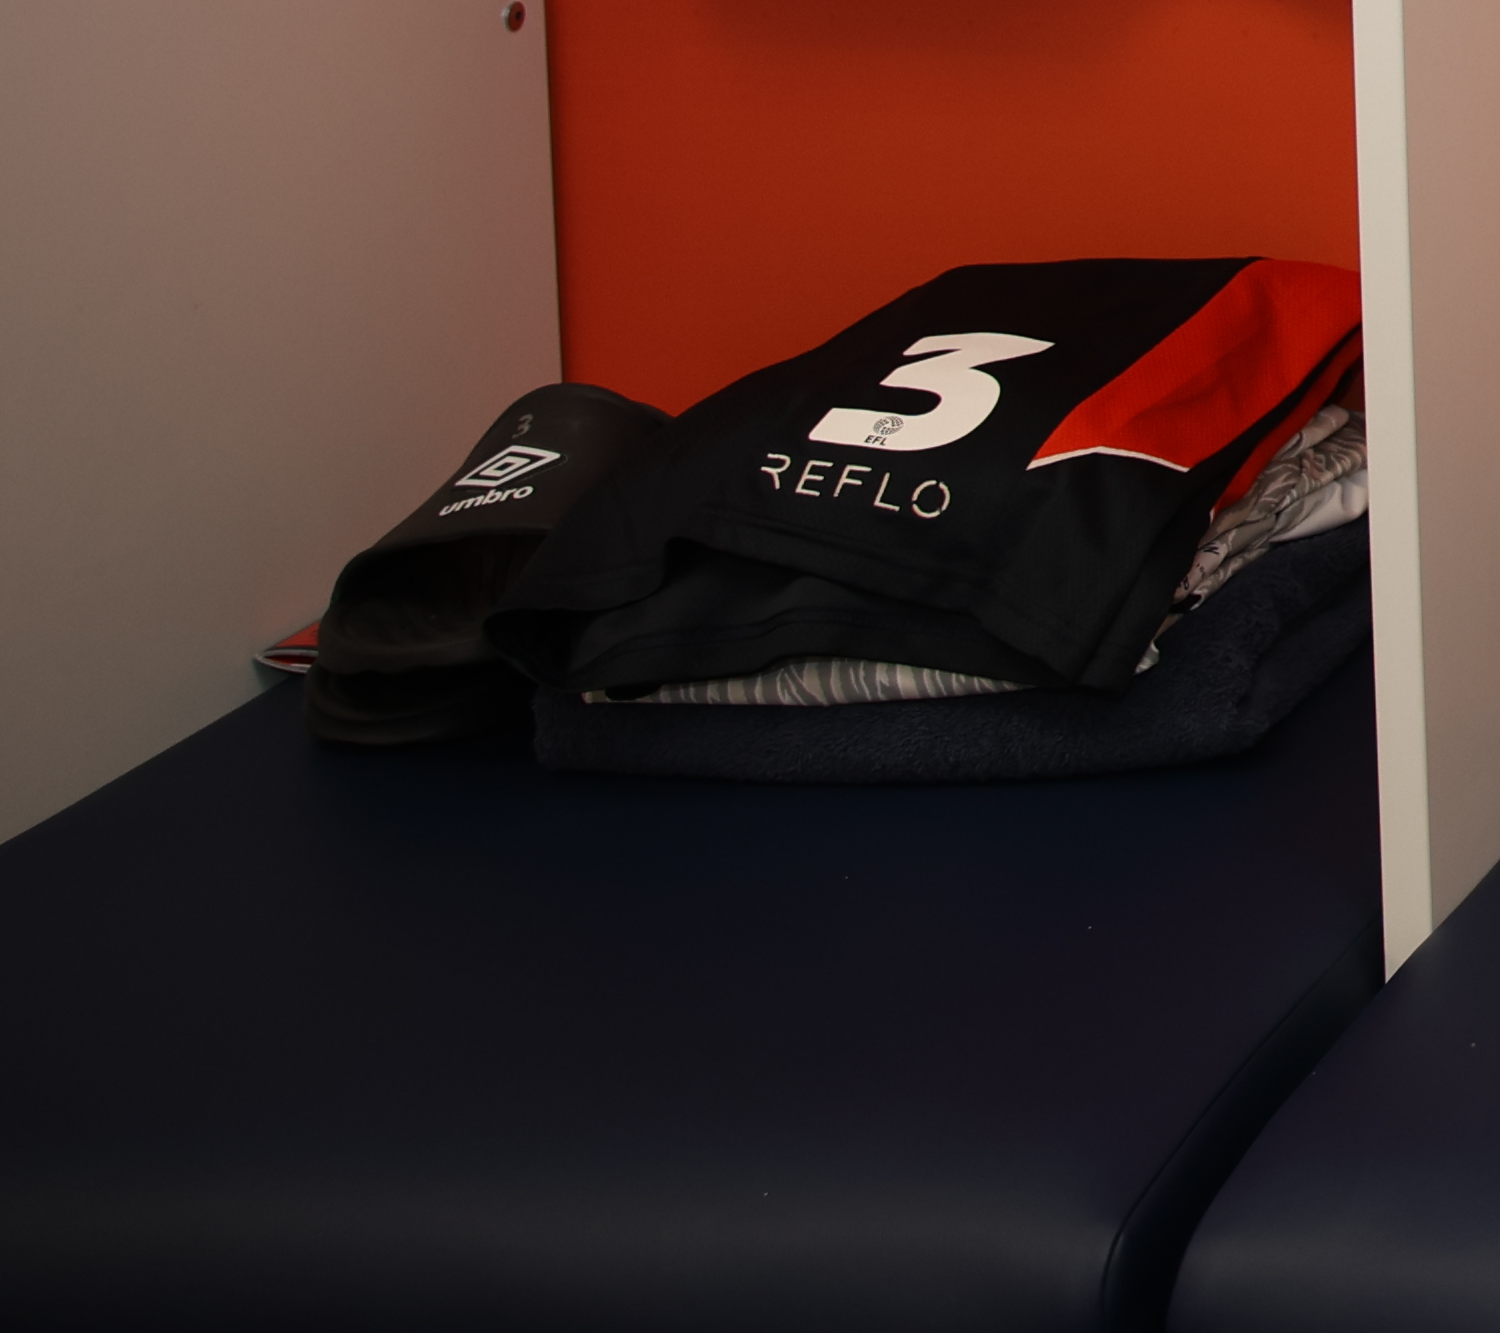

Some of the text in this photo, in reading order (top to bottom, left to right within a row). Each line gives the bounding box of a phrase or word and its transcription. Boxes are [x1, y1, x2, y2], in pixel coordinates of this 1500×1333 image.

[808, 332, 1056, 452] 3
[512, 414, 533, 439] 3
[864, 434, 887, 447] EFL
[760, 452, 951, 519] REFLO
[438, 486, 534, 517] umbro
